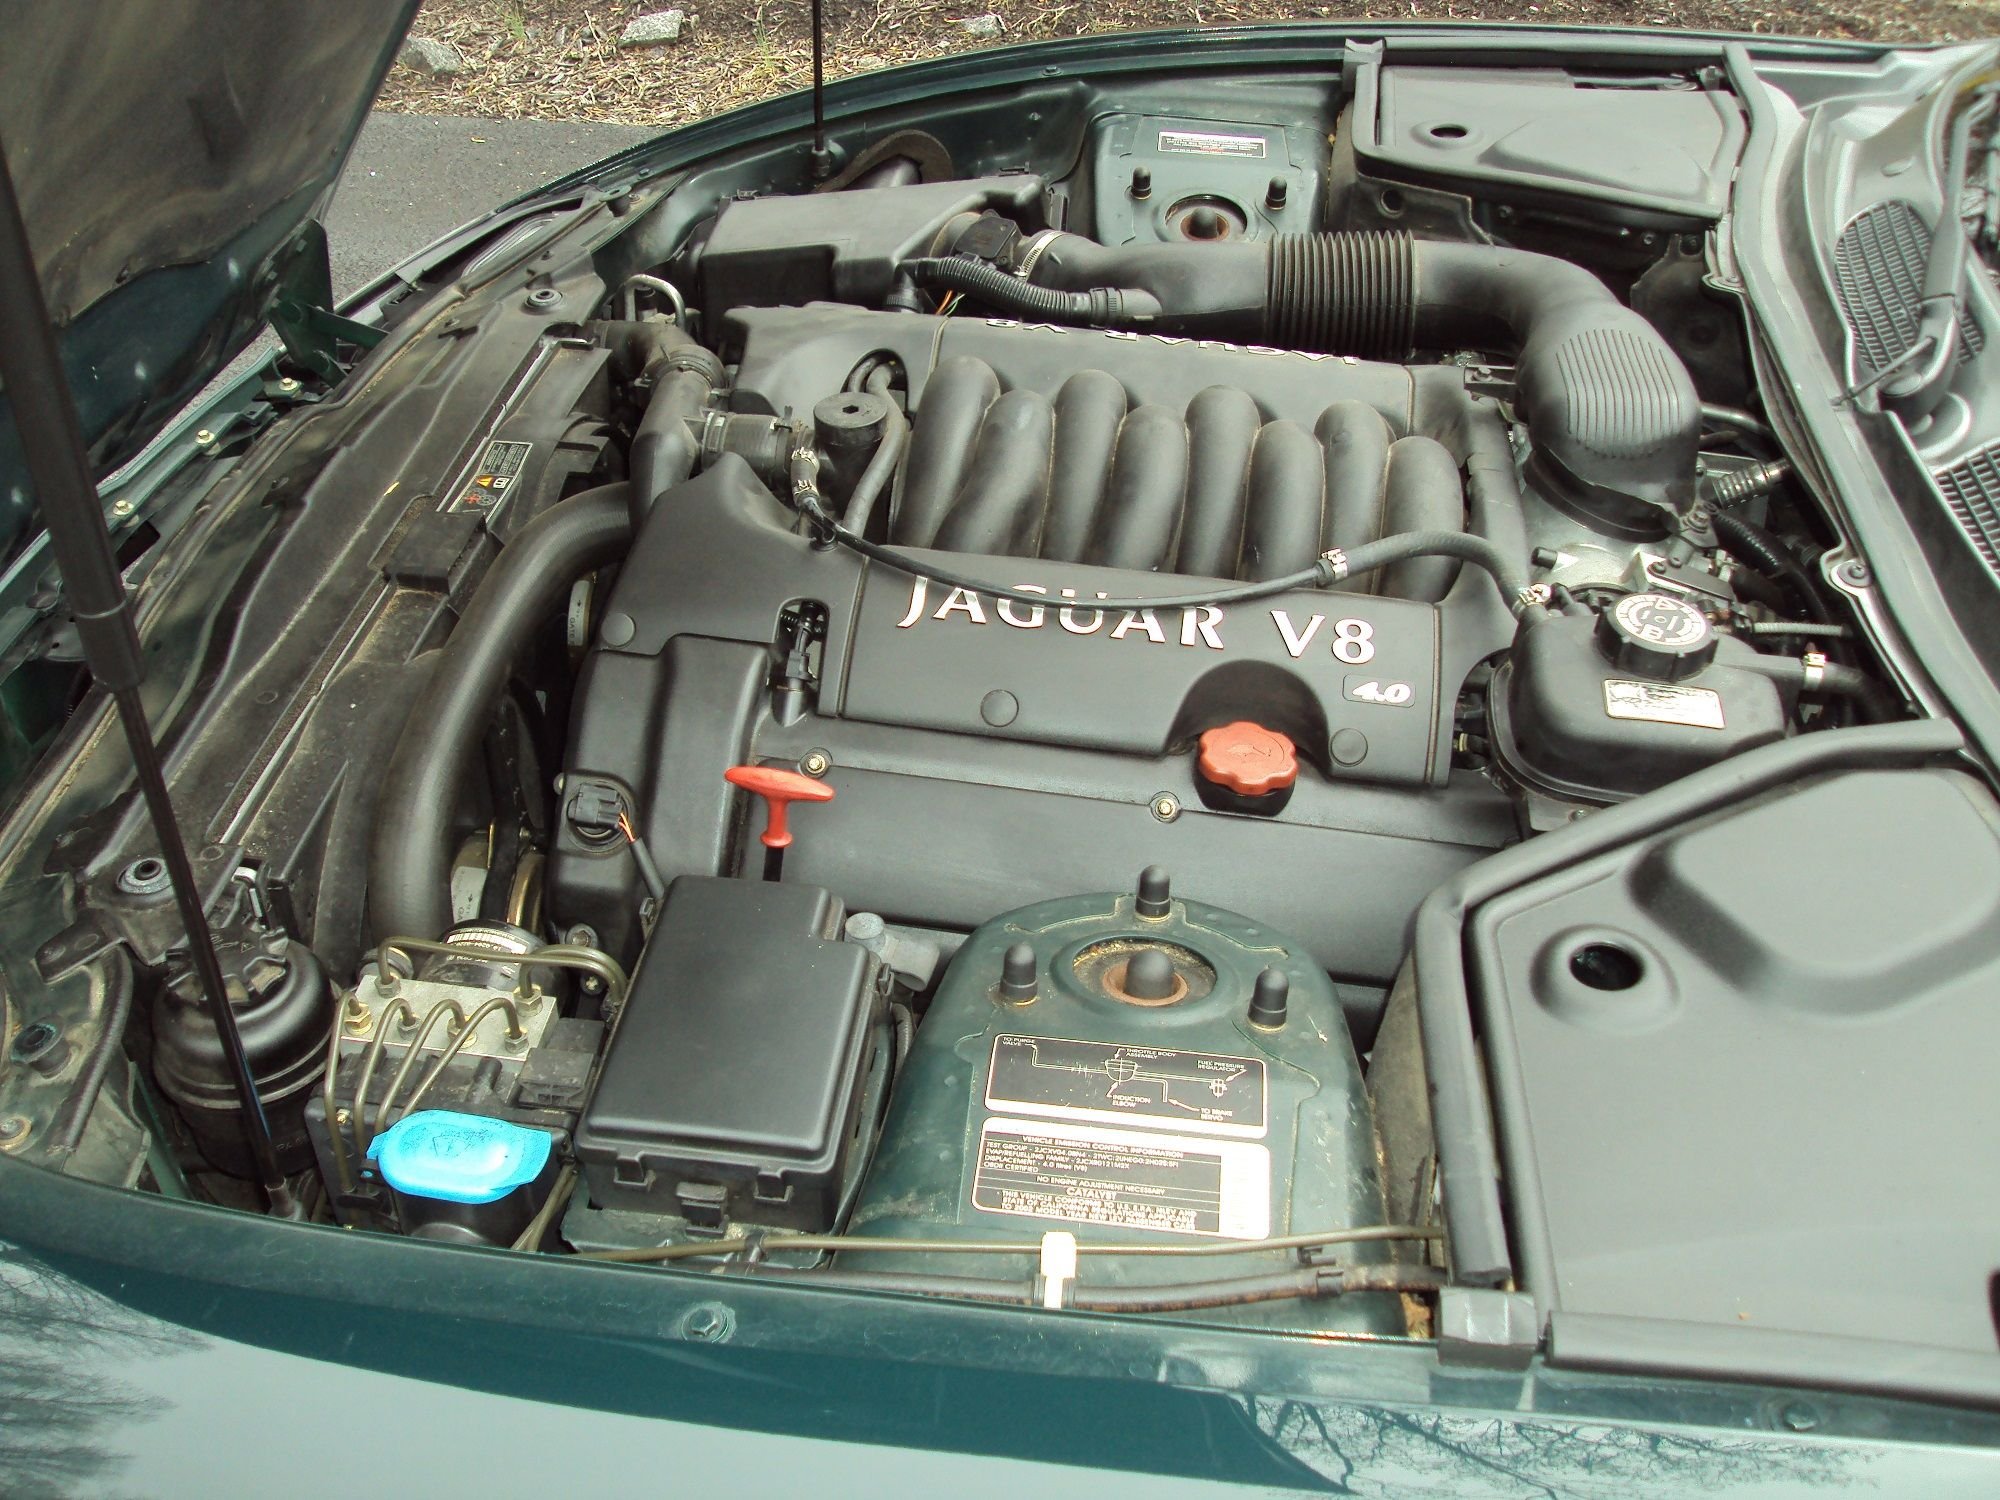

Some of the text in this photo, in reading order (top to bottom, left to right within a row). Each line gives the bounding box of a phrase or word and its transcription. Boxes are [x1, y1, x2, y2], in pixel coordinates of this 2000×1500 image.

[897, 575, 1376, 664] JAGUAR V8
[1352, 681, 1411, 703] 4.0
[1112, 1094, 1150, 1103] INDUCTION
